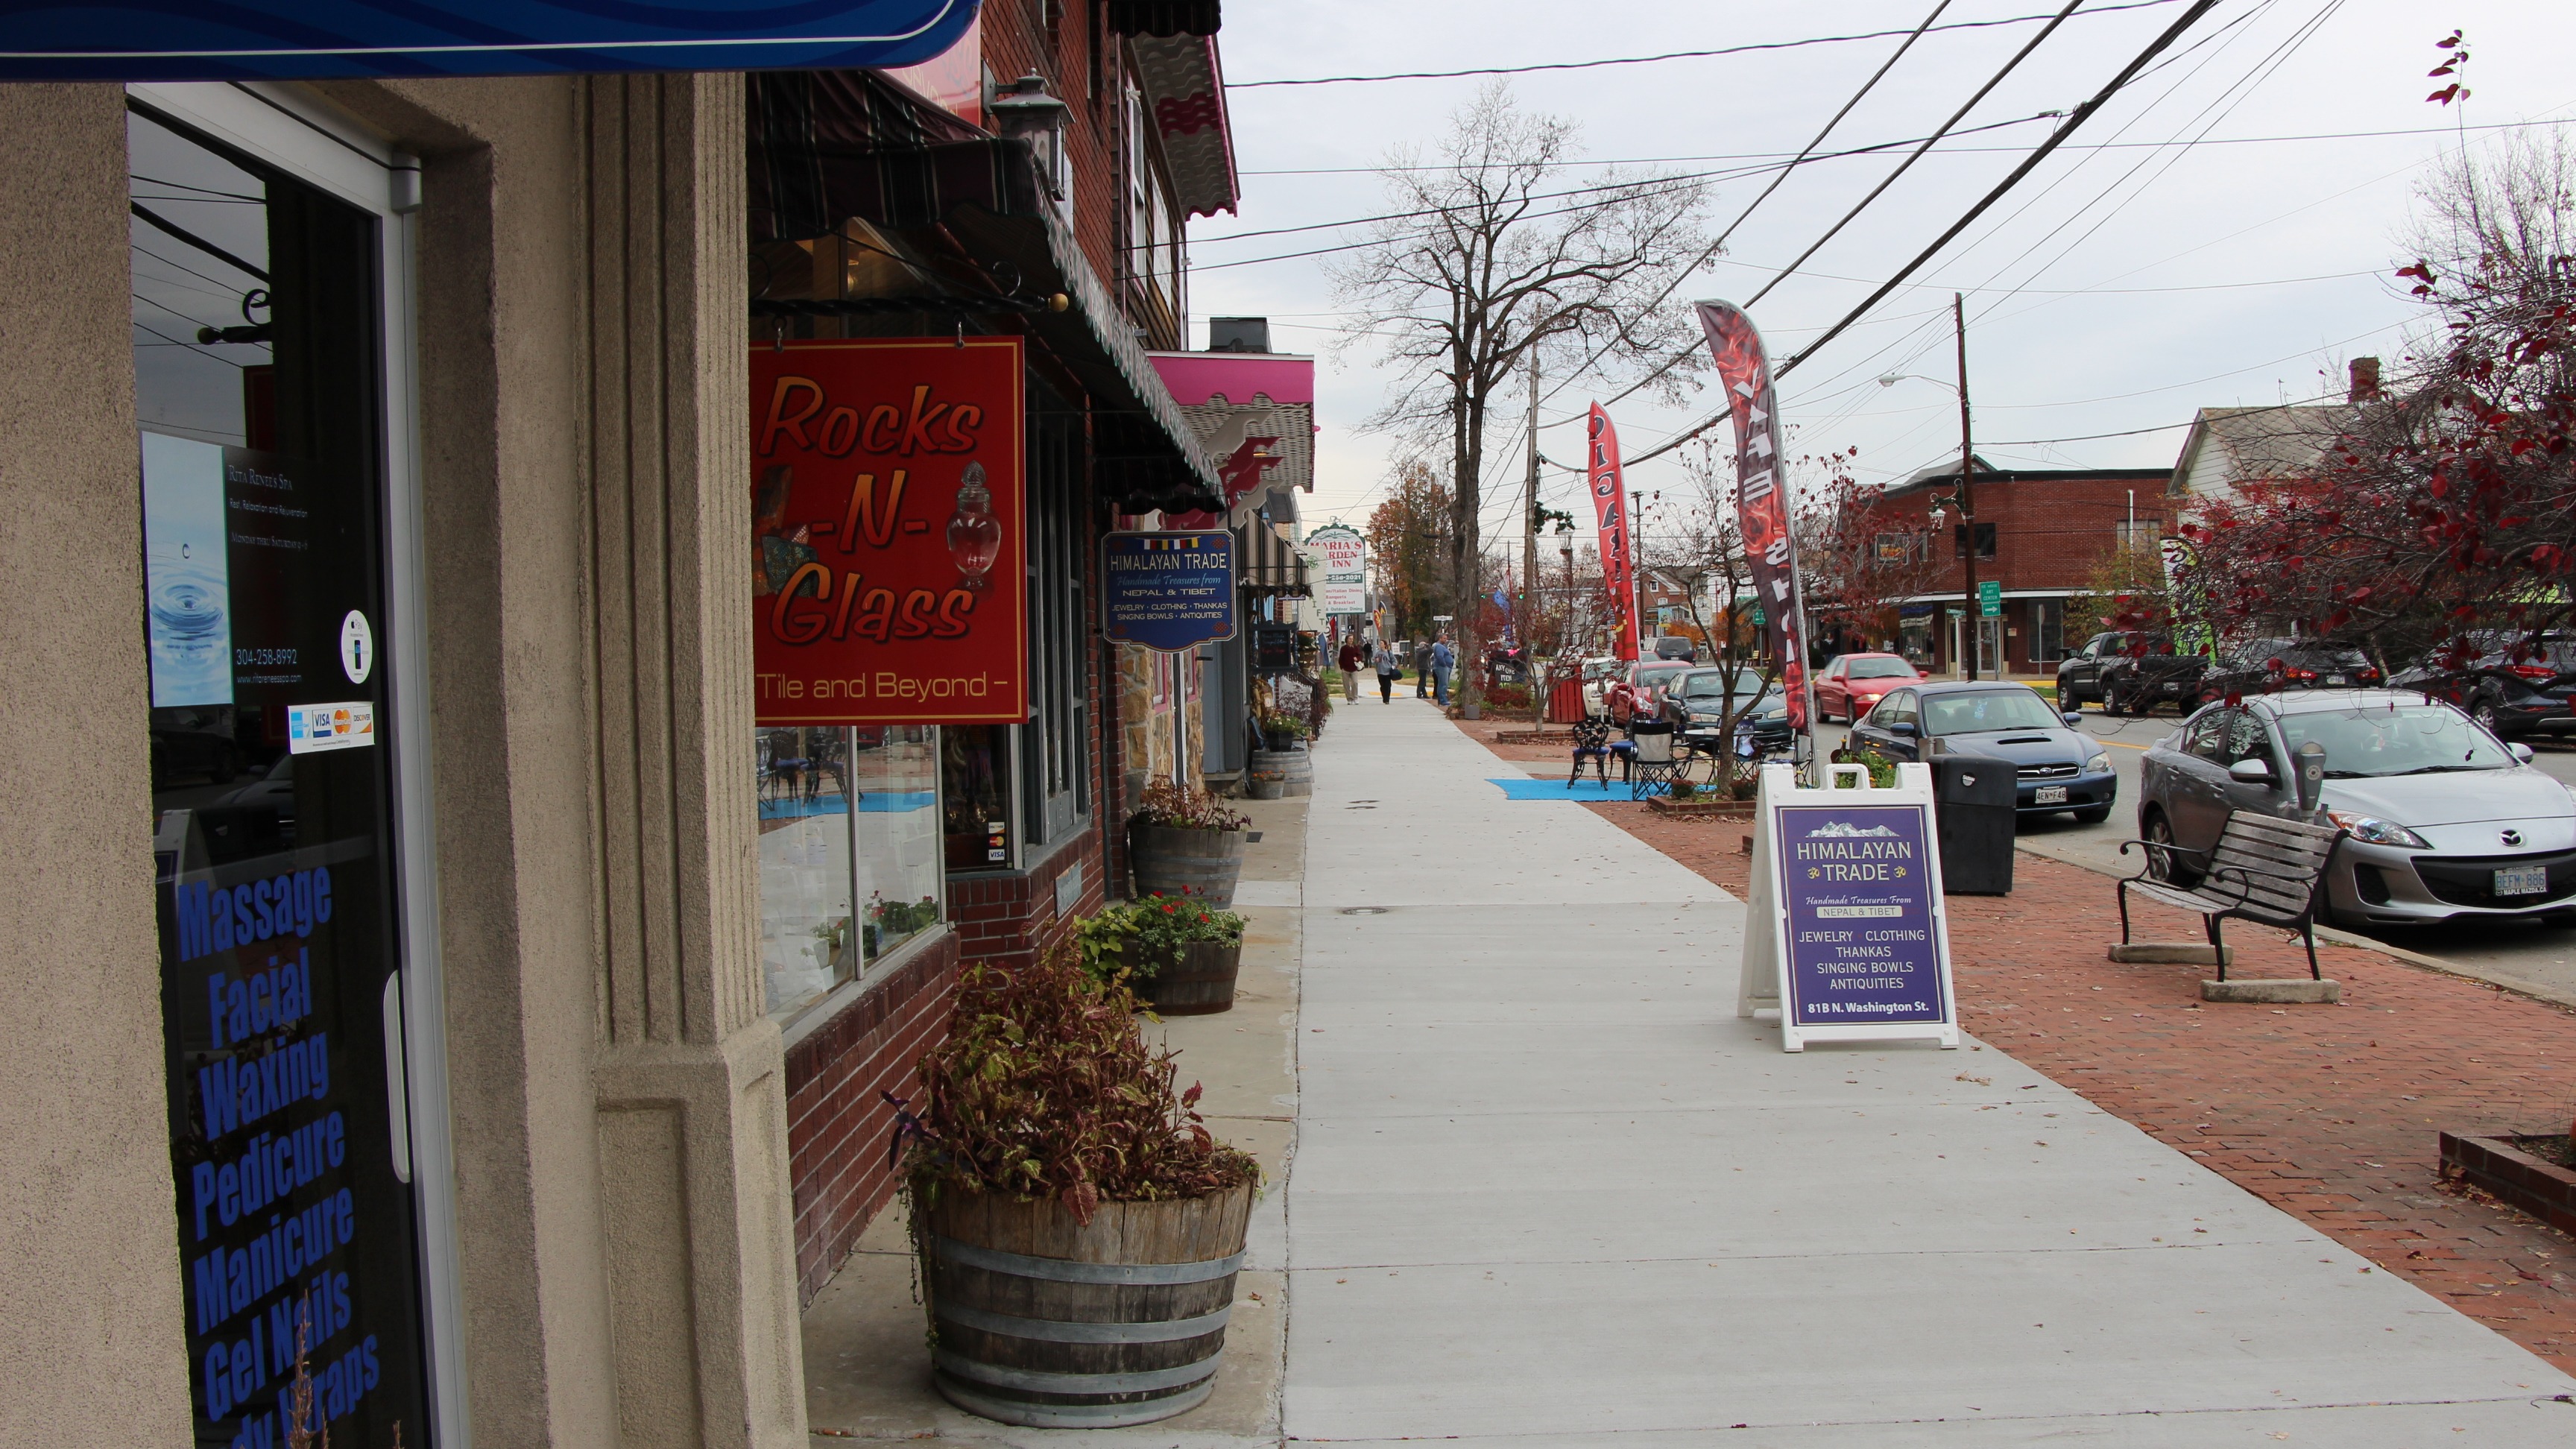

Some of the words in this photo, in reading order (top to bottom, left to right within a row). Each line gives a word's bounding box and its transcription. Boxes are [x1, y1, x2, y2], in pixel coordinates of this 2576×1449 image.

[758, 376, 983, 455] Rocks
[1111, 554, 1180, 571] HIMALAYAN
[1184, 553, 1227, 569] TRADE
[1332, 560, 1351, 568] INN
[1117, 573, 1161, 587] Handmade
[1164, 575, 1200, 585] Treasures
[1201, 572, 1221, 587] from
[771, 562, 975, 644] Glass
[1179, 611, 1223, 619] ANTIQUITIES
[236, 648, 297, 665] 304-258-8992
[757, 672, 804, 699] Tile
[813, 672, 866, 699] and
[875, 671, 987, 703] Beyond
[314, 713, 330, 727] VISA
[353, 713, 370, 722] DISCOVER
[1797, 842, 1912, 860] HIMALAYAN
[1822, 863, 1890, 882] TRADE
[1805, 895, 1849, 906] Handmade
[1850, 895, 1887, 905] Treasures
[1890, 894, 1912, 904] From
[177, 866, 332, 962] Massage
[1823, 907, 1855, 917] NEPAL
[1857, 907, 1865, 916] &
[1868, 906, 1895, 916] TIBET
[1799, 930, 1853, 944] JEWELRY
[1865, 929, 1925, 941] CLOTHING
[1836, 946, 1892, 958] THANKAS
[1817, 962, 1866, 974] SINGING
[1871, 962, 1913, 973] BOWLS
[1830, 977, 1904, 991] ANTIQUITIES
[207, 946, 312, 1050] Facial
[1808, 1002, 1830, 1014] 81B
[1831, 1002, 1845, 1014] N.
[1846, 1000, 1913, 1015] Washington
[1914, 1000, 1929, 1012] St.
[199, 1031, 329, 1143] Waxing
[192, 1110, 345, 1242] Pedicure
[193, 1186, 354, 1336] Manicure
[205, 1314, 266, 1423] Gel
[270, 1269, 352, 1377] Nails
